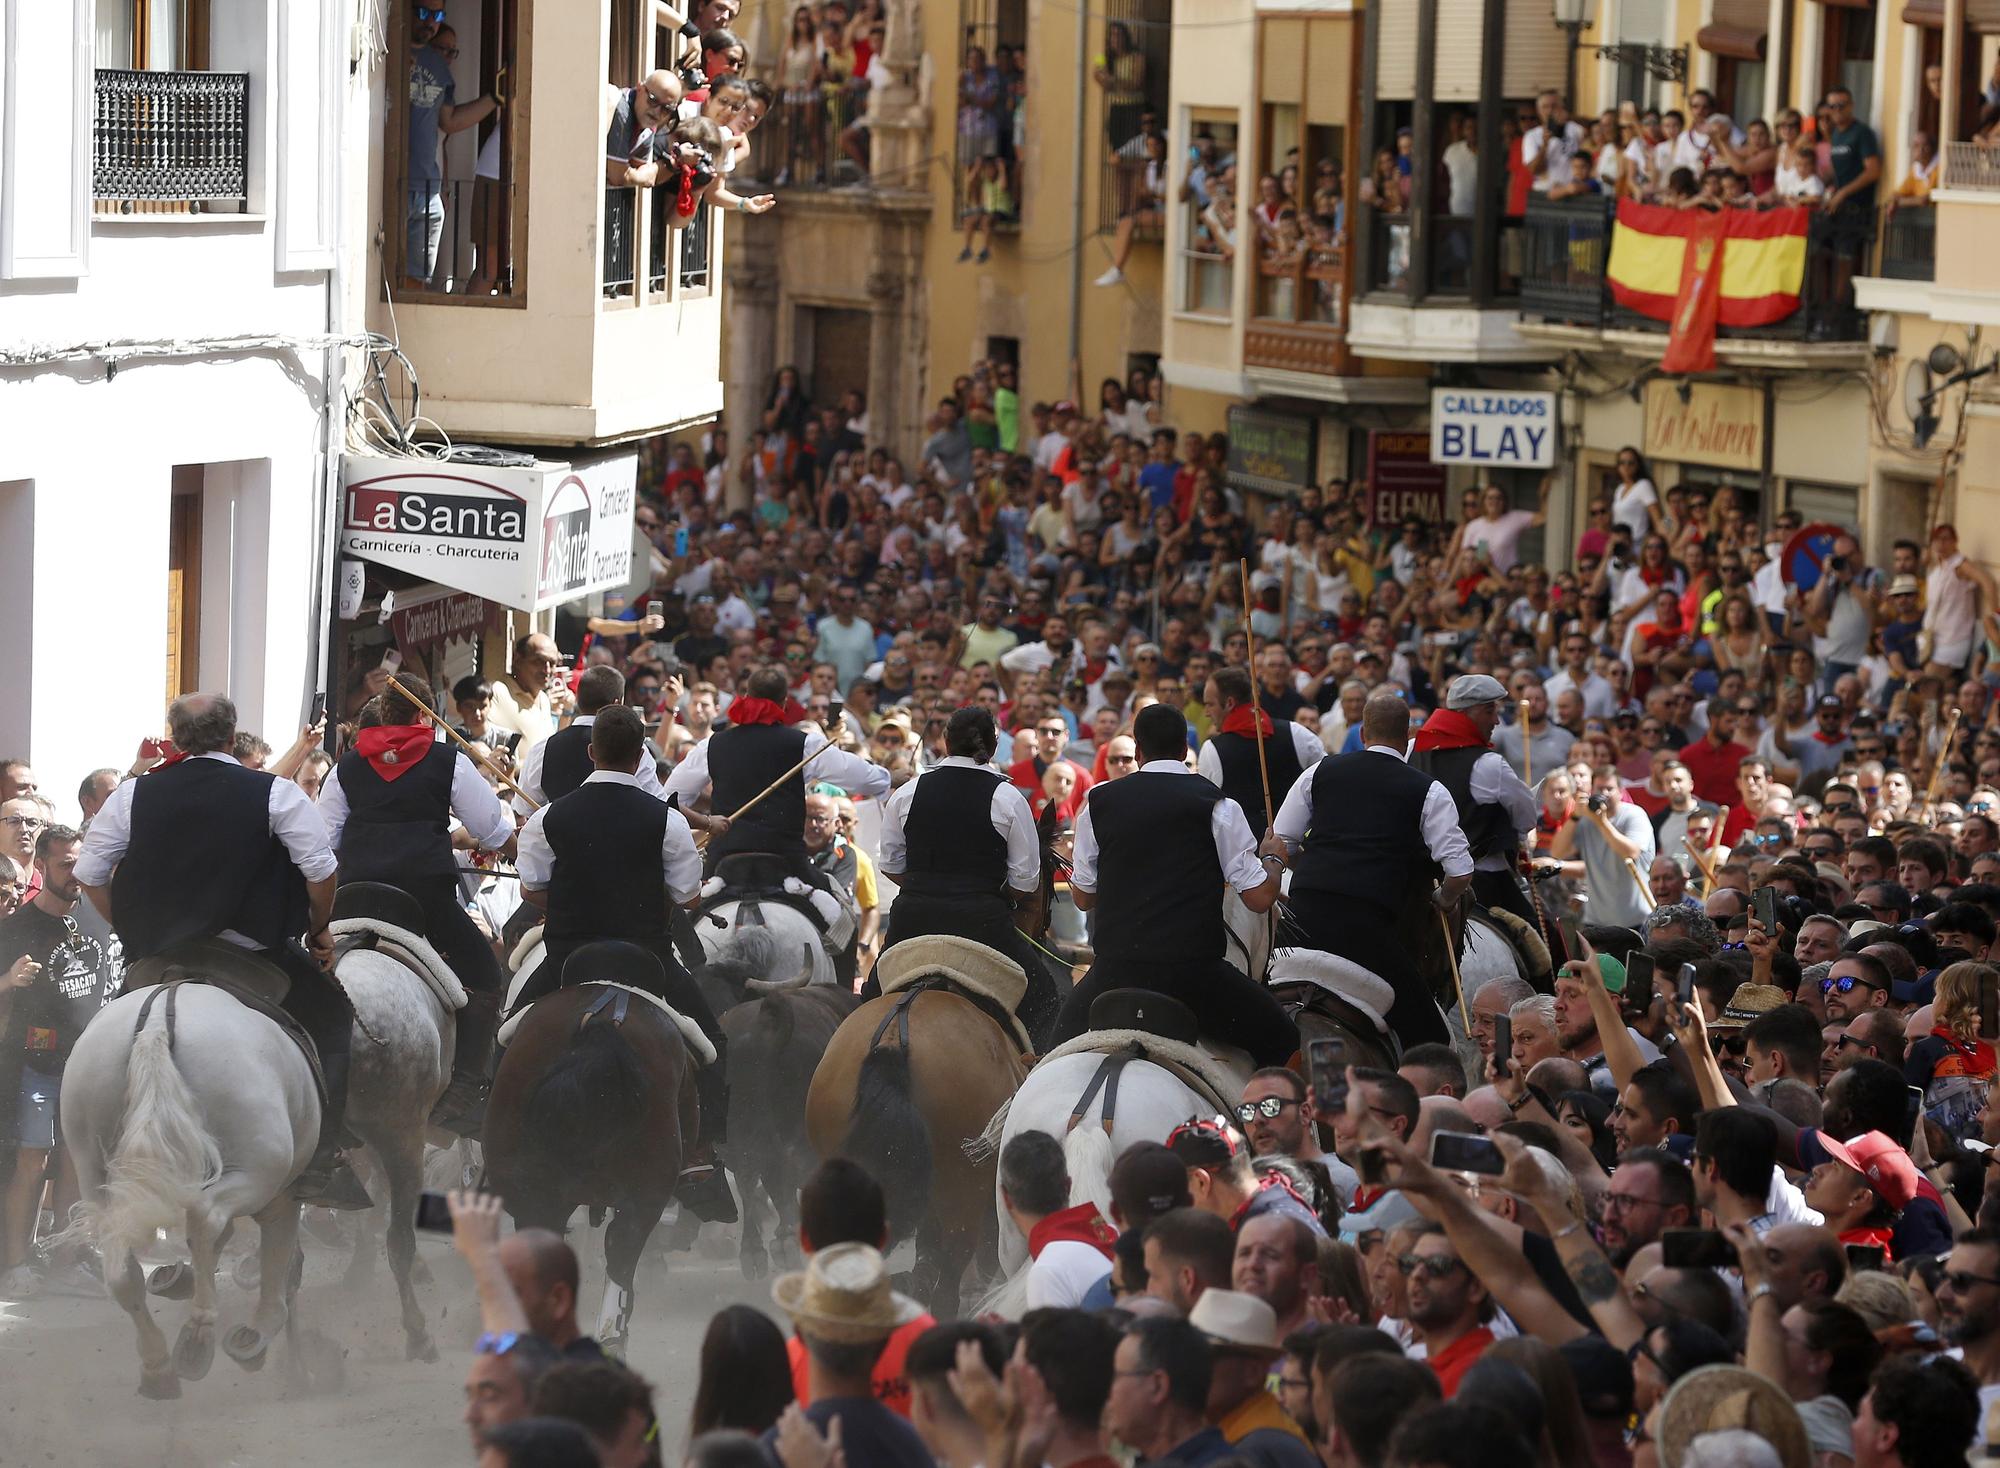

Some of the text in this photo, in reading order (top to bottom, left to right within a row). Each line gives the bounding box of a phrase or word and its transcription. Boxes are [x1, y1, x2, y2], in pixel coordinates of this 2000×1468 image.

[1443, 395, 1547, 417] CALZADOS
[1442, 424, 1547, 461] BLAY
[348, 491, 522, 539] LaSanta
[1377, 491, 1441, 524] ELENA
[349, 537, 421, 554] Carnicería
[436, 543, 519, 561] Charcutería
[48, 942, 67, 965] NOBLE
[58, 972, 97, 993] DESACATO
[67, 987, 92, 999] SEGORBE
